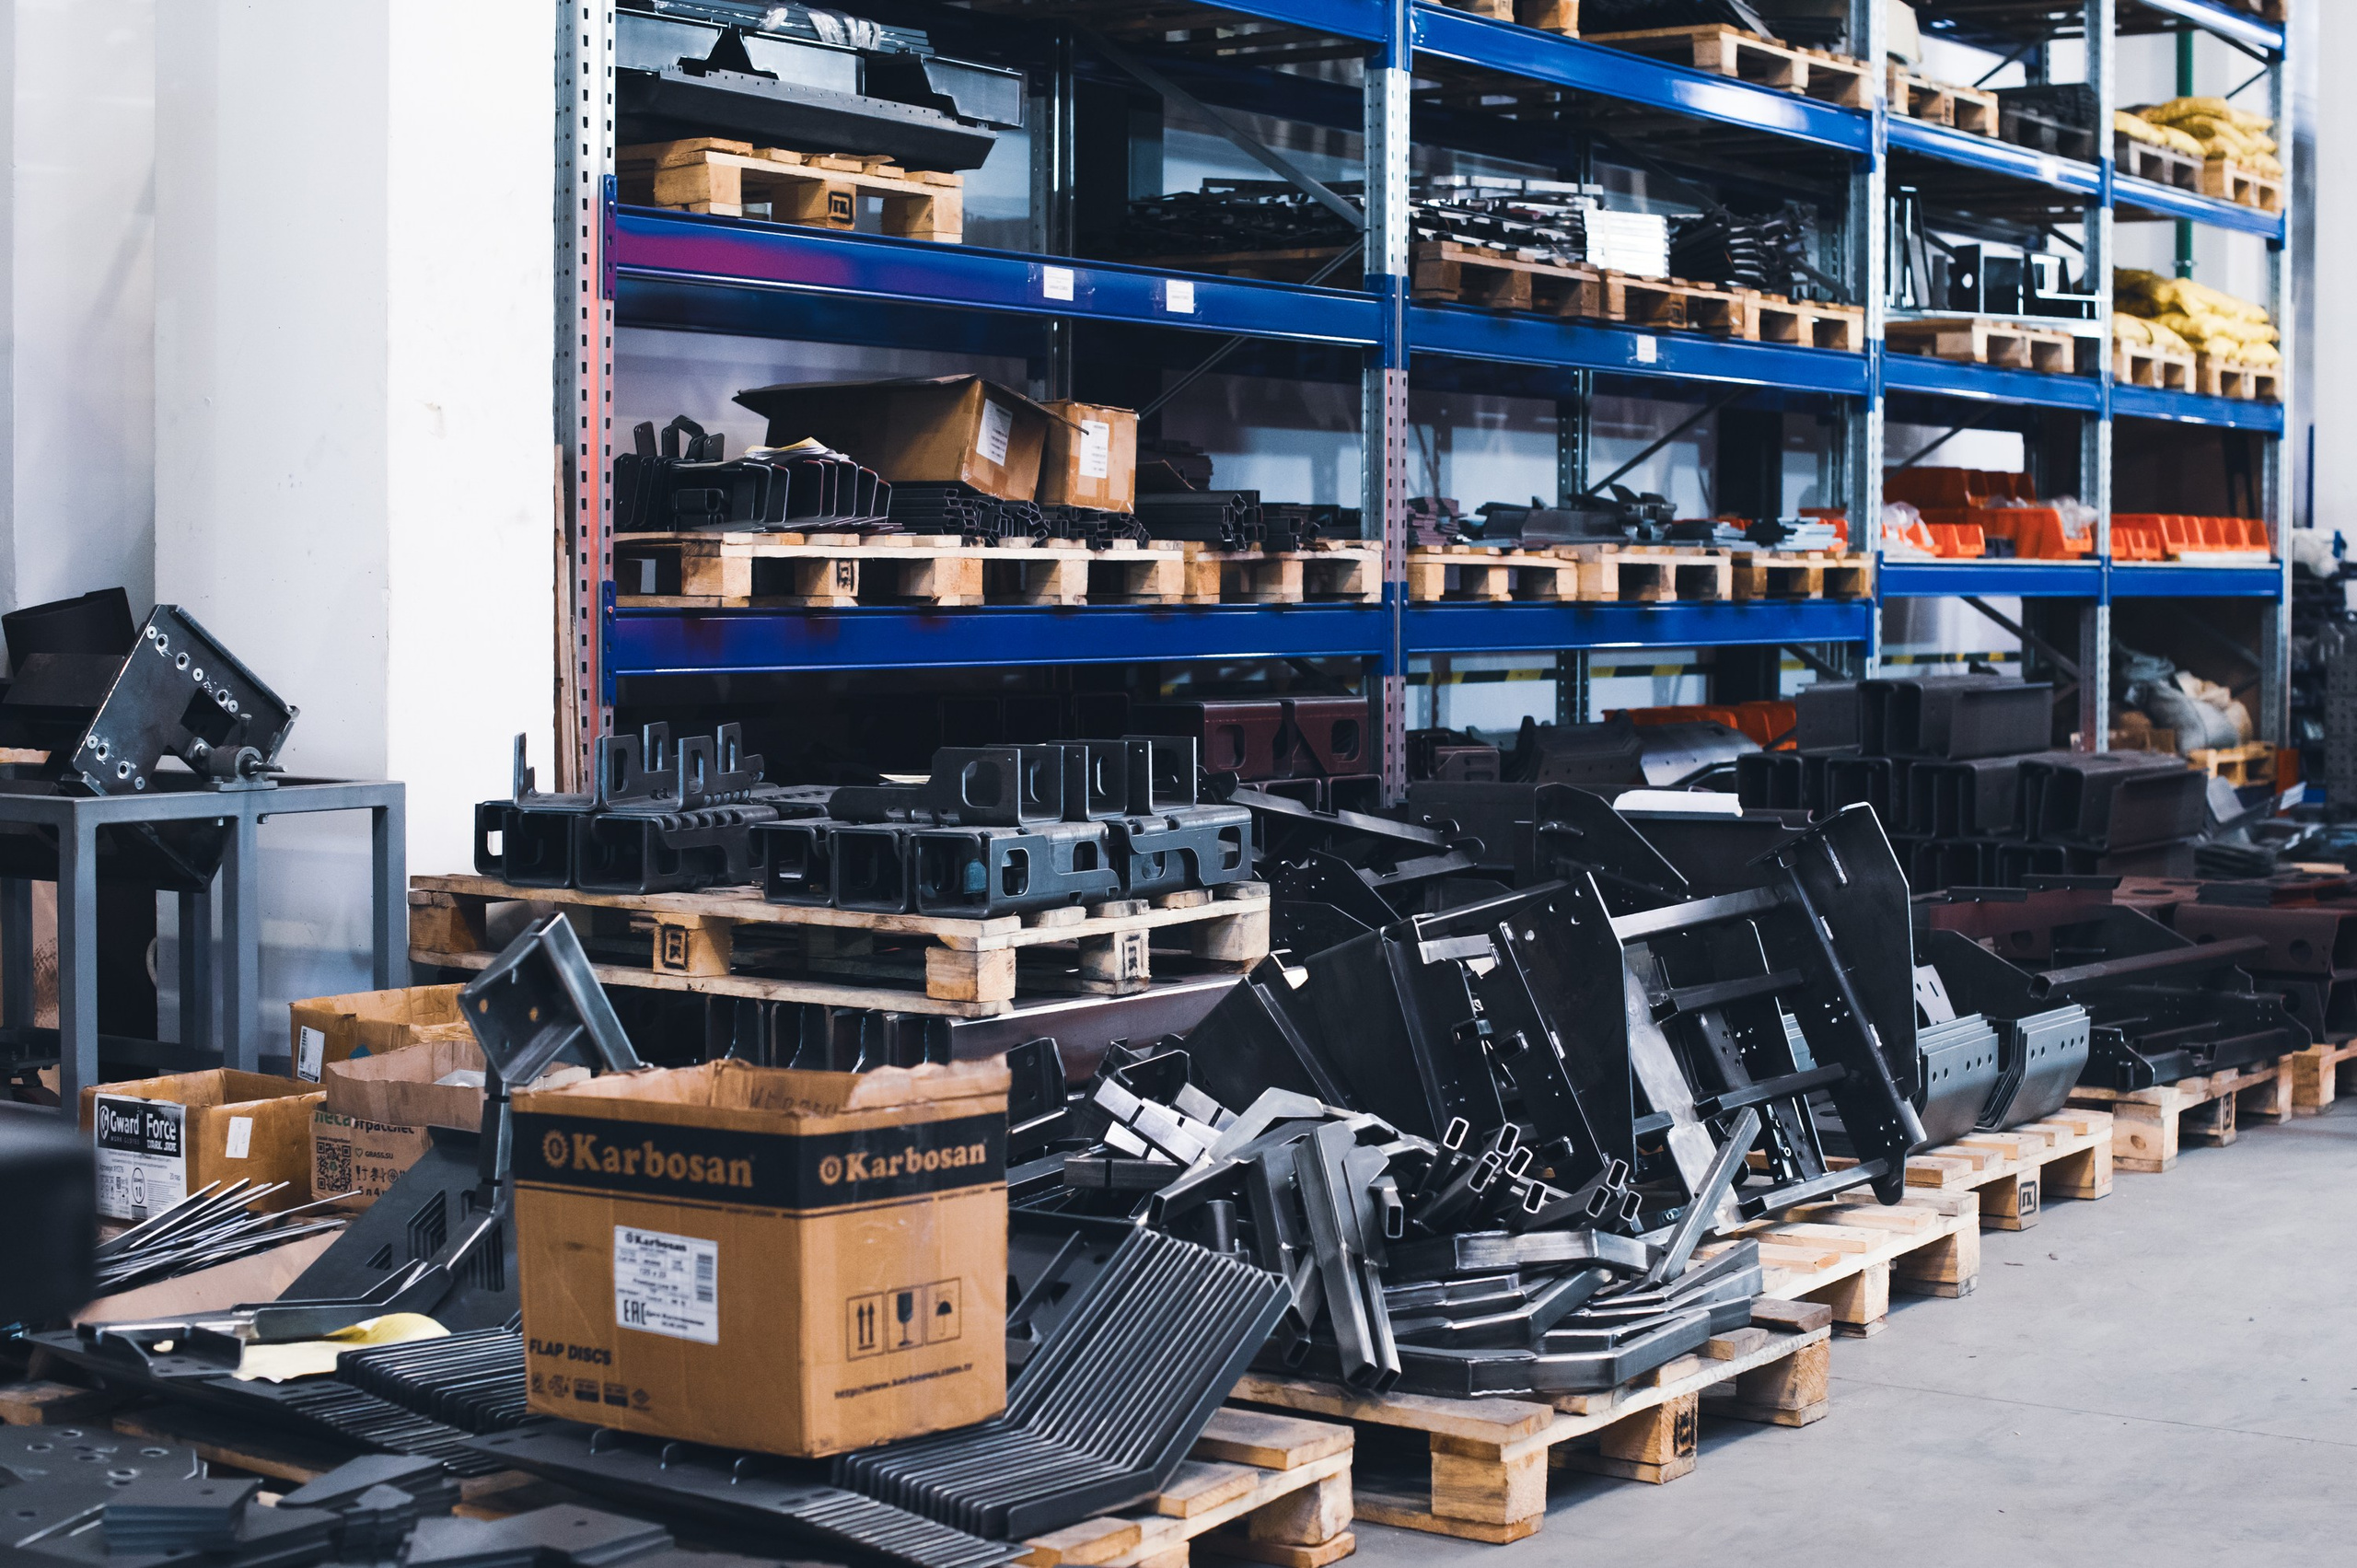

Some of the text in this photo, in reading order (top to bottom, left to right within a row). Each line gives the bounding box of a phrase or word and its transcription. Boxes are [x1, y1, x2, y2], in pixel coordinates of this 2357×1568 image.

[110, 1110, 177, 1141] Gward Force
[572, 1132, 753, 1188] Karbosan
[845, 1143, 987, 1182] Karbosan
[135, 1186, 143, 1198] 10
[528, 1338, 612, 1366] FLAP DISCS
